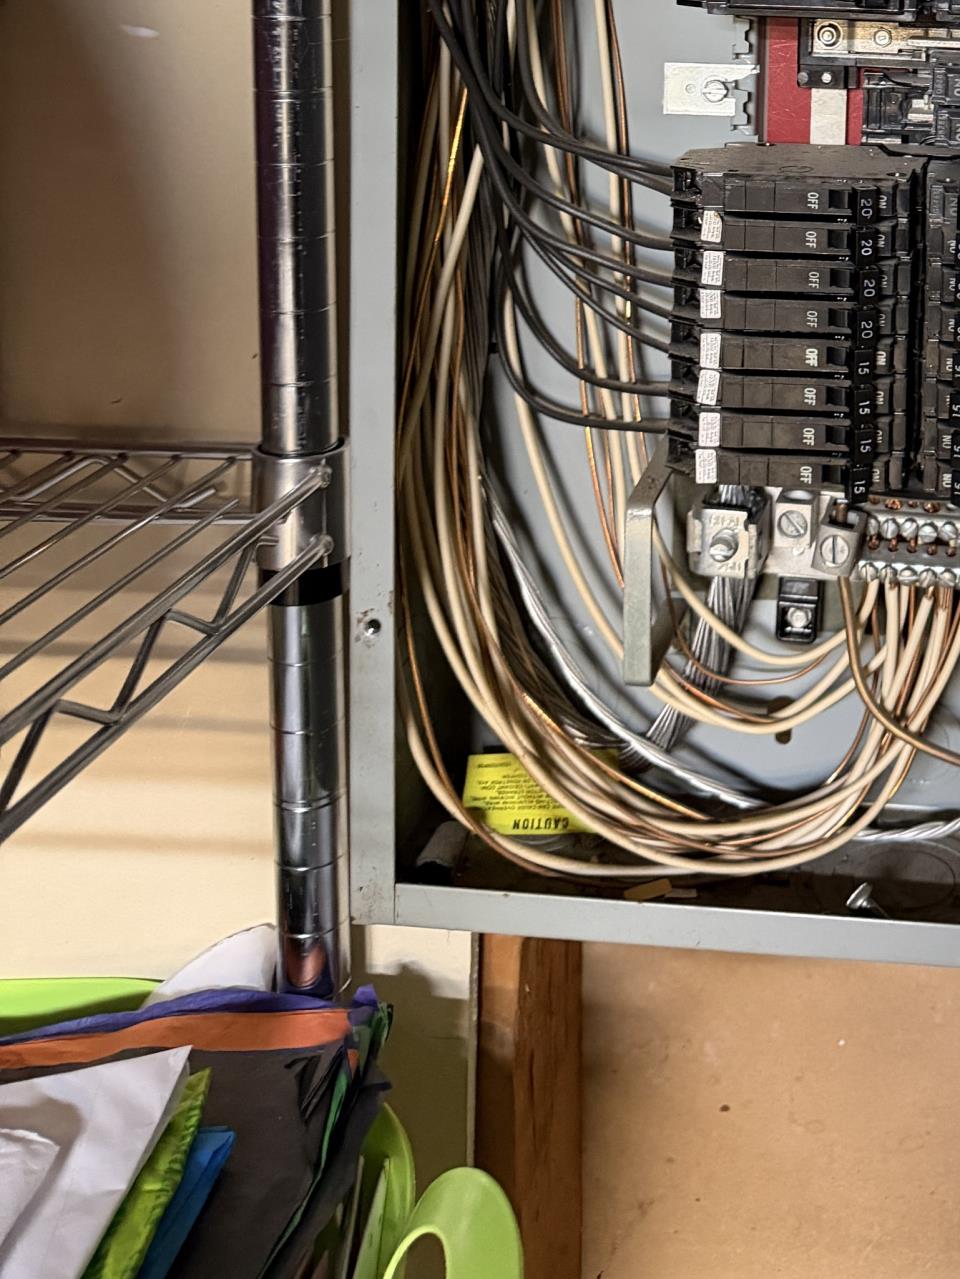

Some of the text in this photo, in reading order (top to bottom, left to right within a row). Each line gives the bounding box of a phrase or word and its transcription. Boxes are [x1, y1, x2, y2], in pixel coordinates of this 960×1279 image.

[807, 191, 819, 210] OFF
[860, 198, 873, 218] 20
[805, 231, 817, 249] OFF
[861, 239, 873, 256] 20
[808, 271, 820, 289] OFF
[863, 279, 875, 297] 20
[806, 310, 818, 328] OFF
[861, 320, 873, 339] 20
[805, 348, 818, 367] OFF
[876, 351, 887, 366] ON
[858, 361, 870, 375] 15
[804, 387, 816, 406] OFF
[859, 400, 870, 415] 15
[802, 427, 815, 446] OFF
[942, 434, 952, 449] ON
[860, 439, 872, 453] 15
[800, 466, 812, 485] OFF
[942, 473, 952, 488] ON
[854, 480, 866, 494] 15
[512, 816, 569, 830] CAUTION
